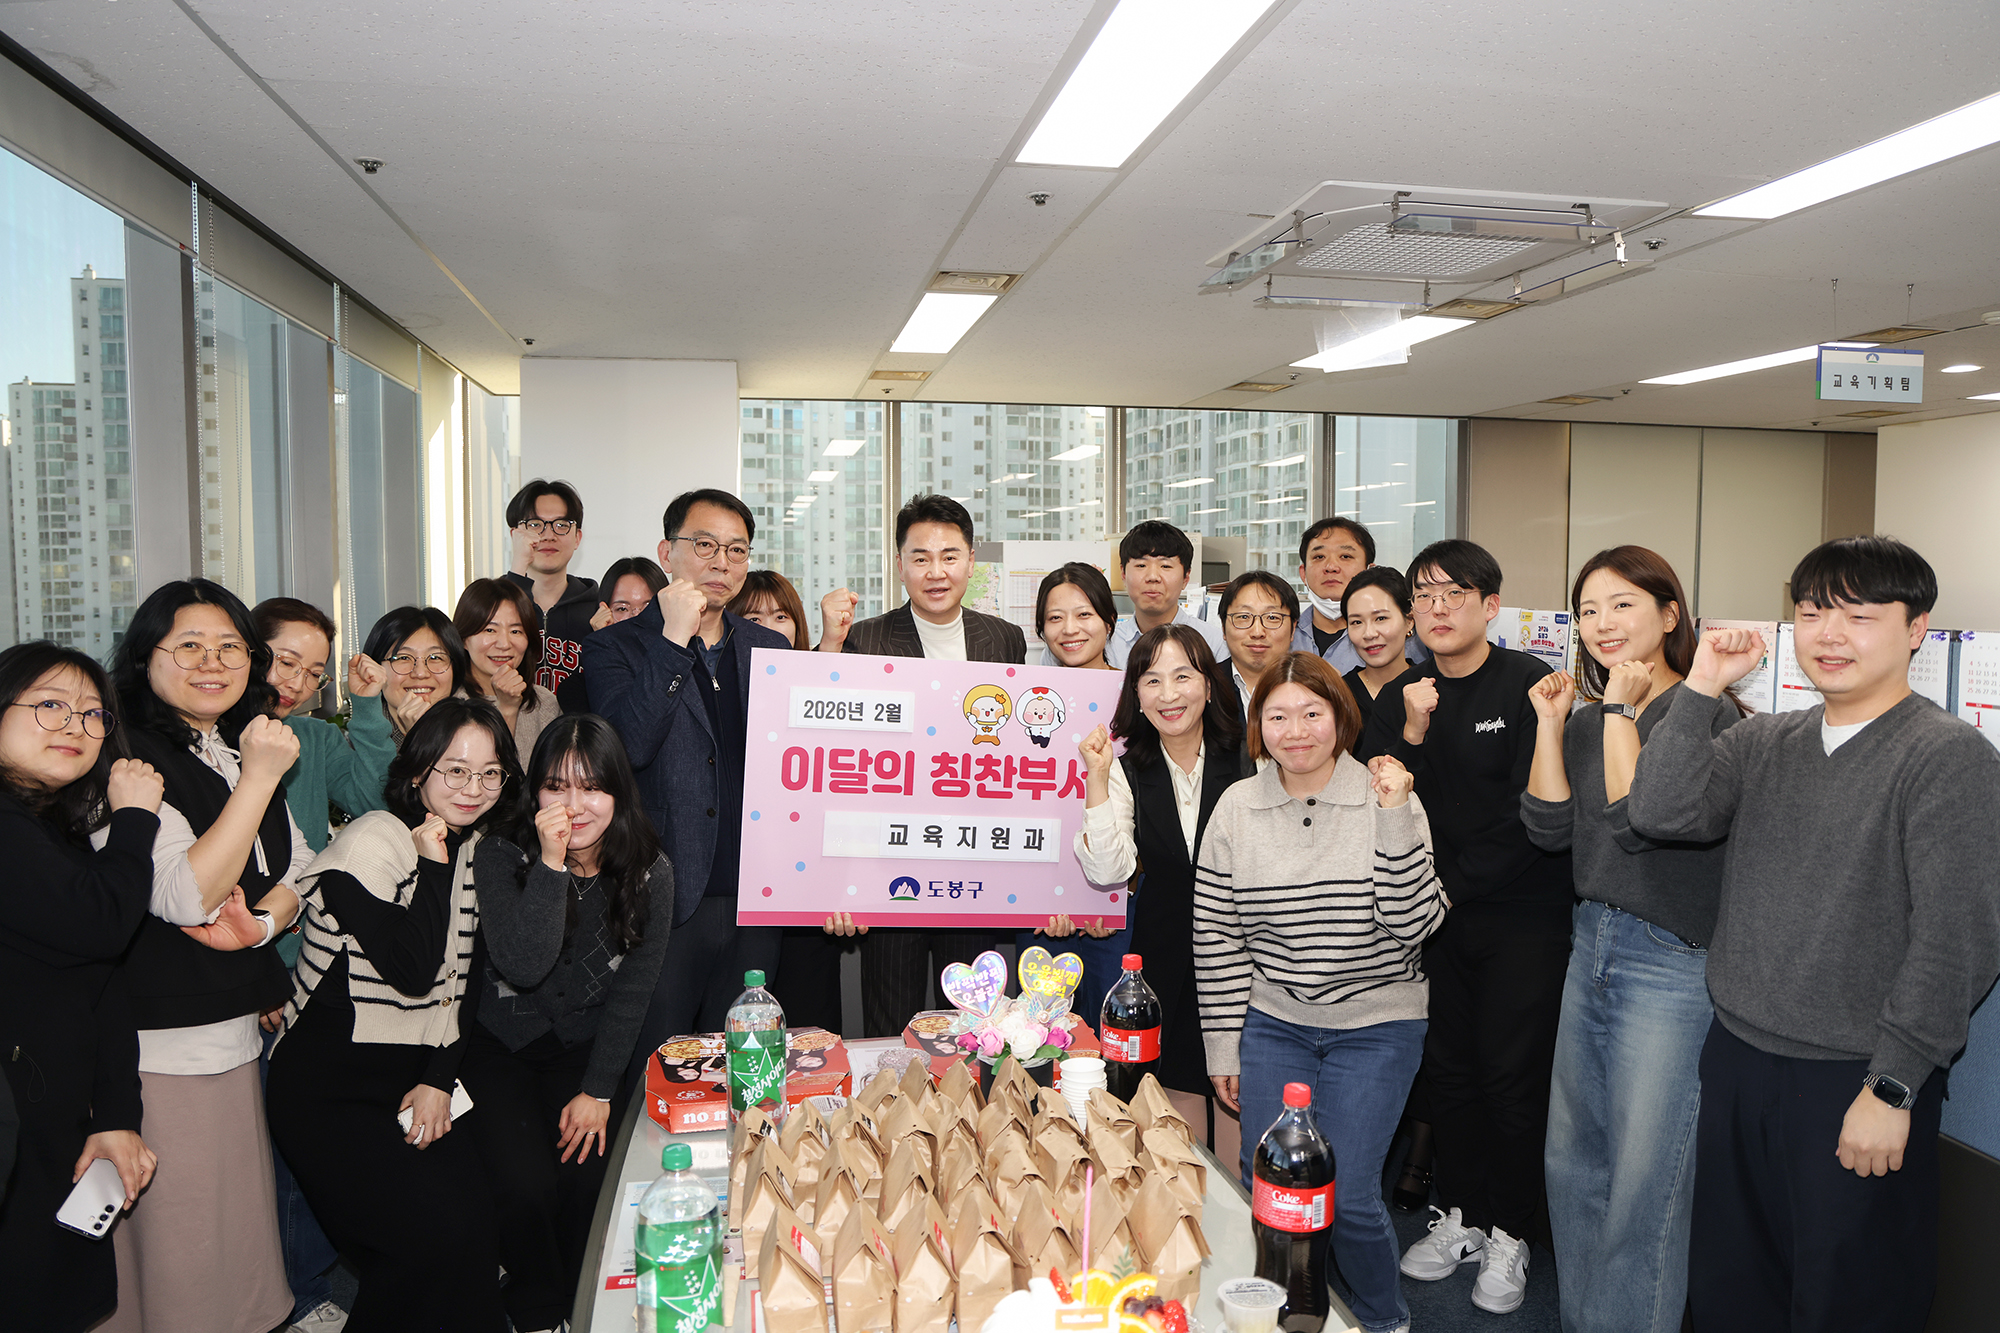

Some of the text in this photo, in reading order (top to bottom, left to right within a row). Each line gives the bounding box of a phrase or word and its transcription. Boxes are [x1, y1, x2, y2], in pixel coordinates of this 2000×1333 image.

[1833, 374, 1910, 391] 교육기획팀
[803, 699, 902, 723] 2026년 2월
[1974, 711, 1982, 728] 1
[780, 746, 916, 797] 이달의
[887, 823, 1045, 851] 교육지원과
[927, 880, 984, 899] 도봉구
[1103, 1028, 1119, 1040] Coke
[683, 1112, 709, 1124] no
[1272, 1190, 1300, 1205] Coke
